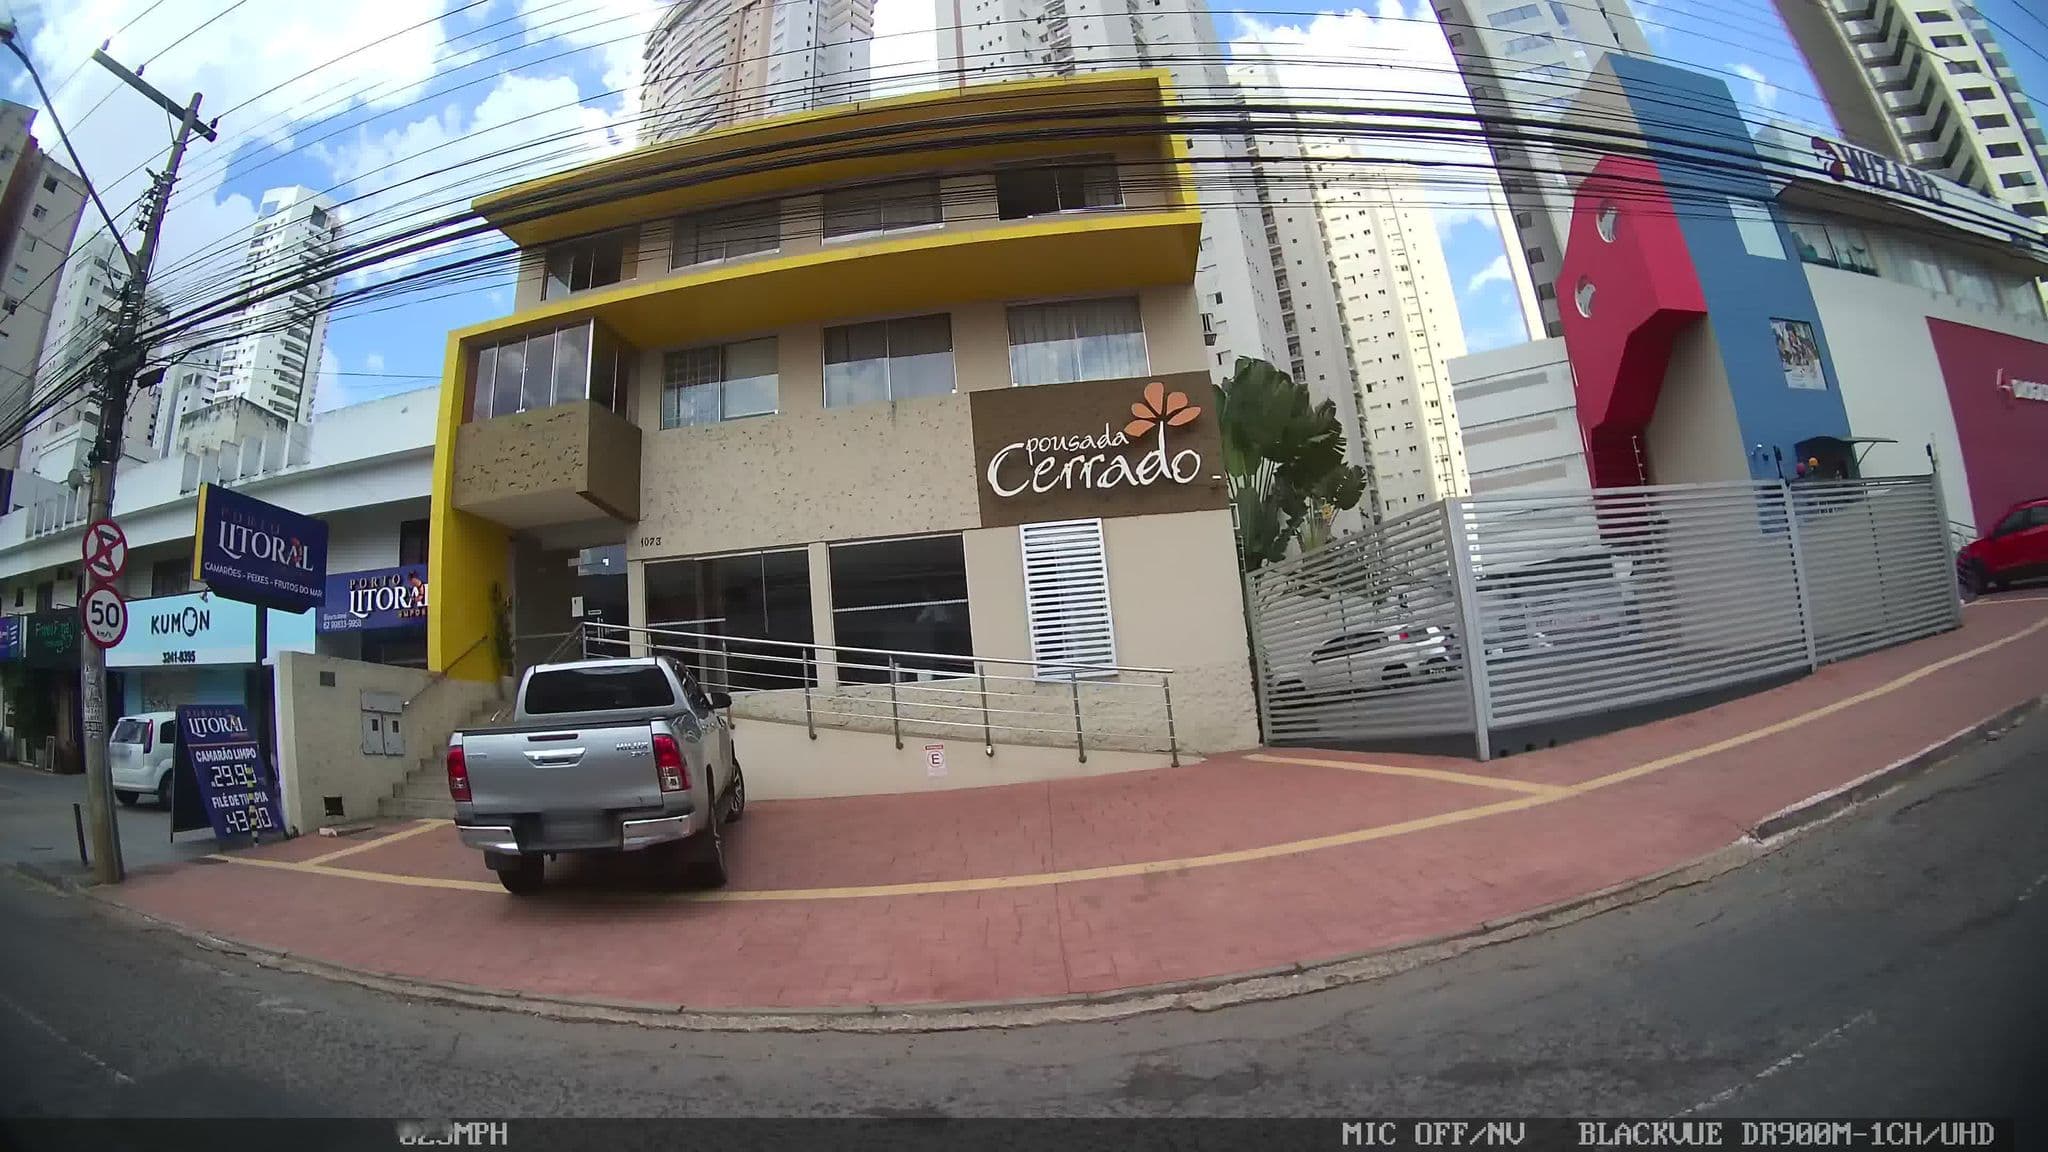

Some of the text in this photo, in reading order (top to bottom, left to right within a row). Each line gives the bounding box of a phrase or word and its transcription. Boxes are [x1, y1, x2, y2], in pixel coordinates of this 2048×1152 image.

[1025, 422, 1130, 466] pousada
[987, 420, 1201, 497] Cerrado
[218, 520, 314, 573] LITORAL
[641, 537, 662, 547] 1073
[246, 572, 269, 585] PEIXES
[274, 580, 298, 593] FRUTOS
[299, 585, 309, 595] DO
[91, 600, 120, 628] 50
[151, 606, 210, 637] KUMON
[188, 717, 247, 738] LITORAL
[195, 747, 257, 762] CAMARÃO LIMPO
[931, 753, 941, 765] E
[211, 792, 229, 809] FILÉ
[228, 794, 240, 807] DE
